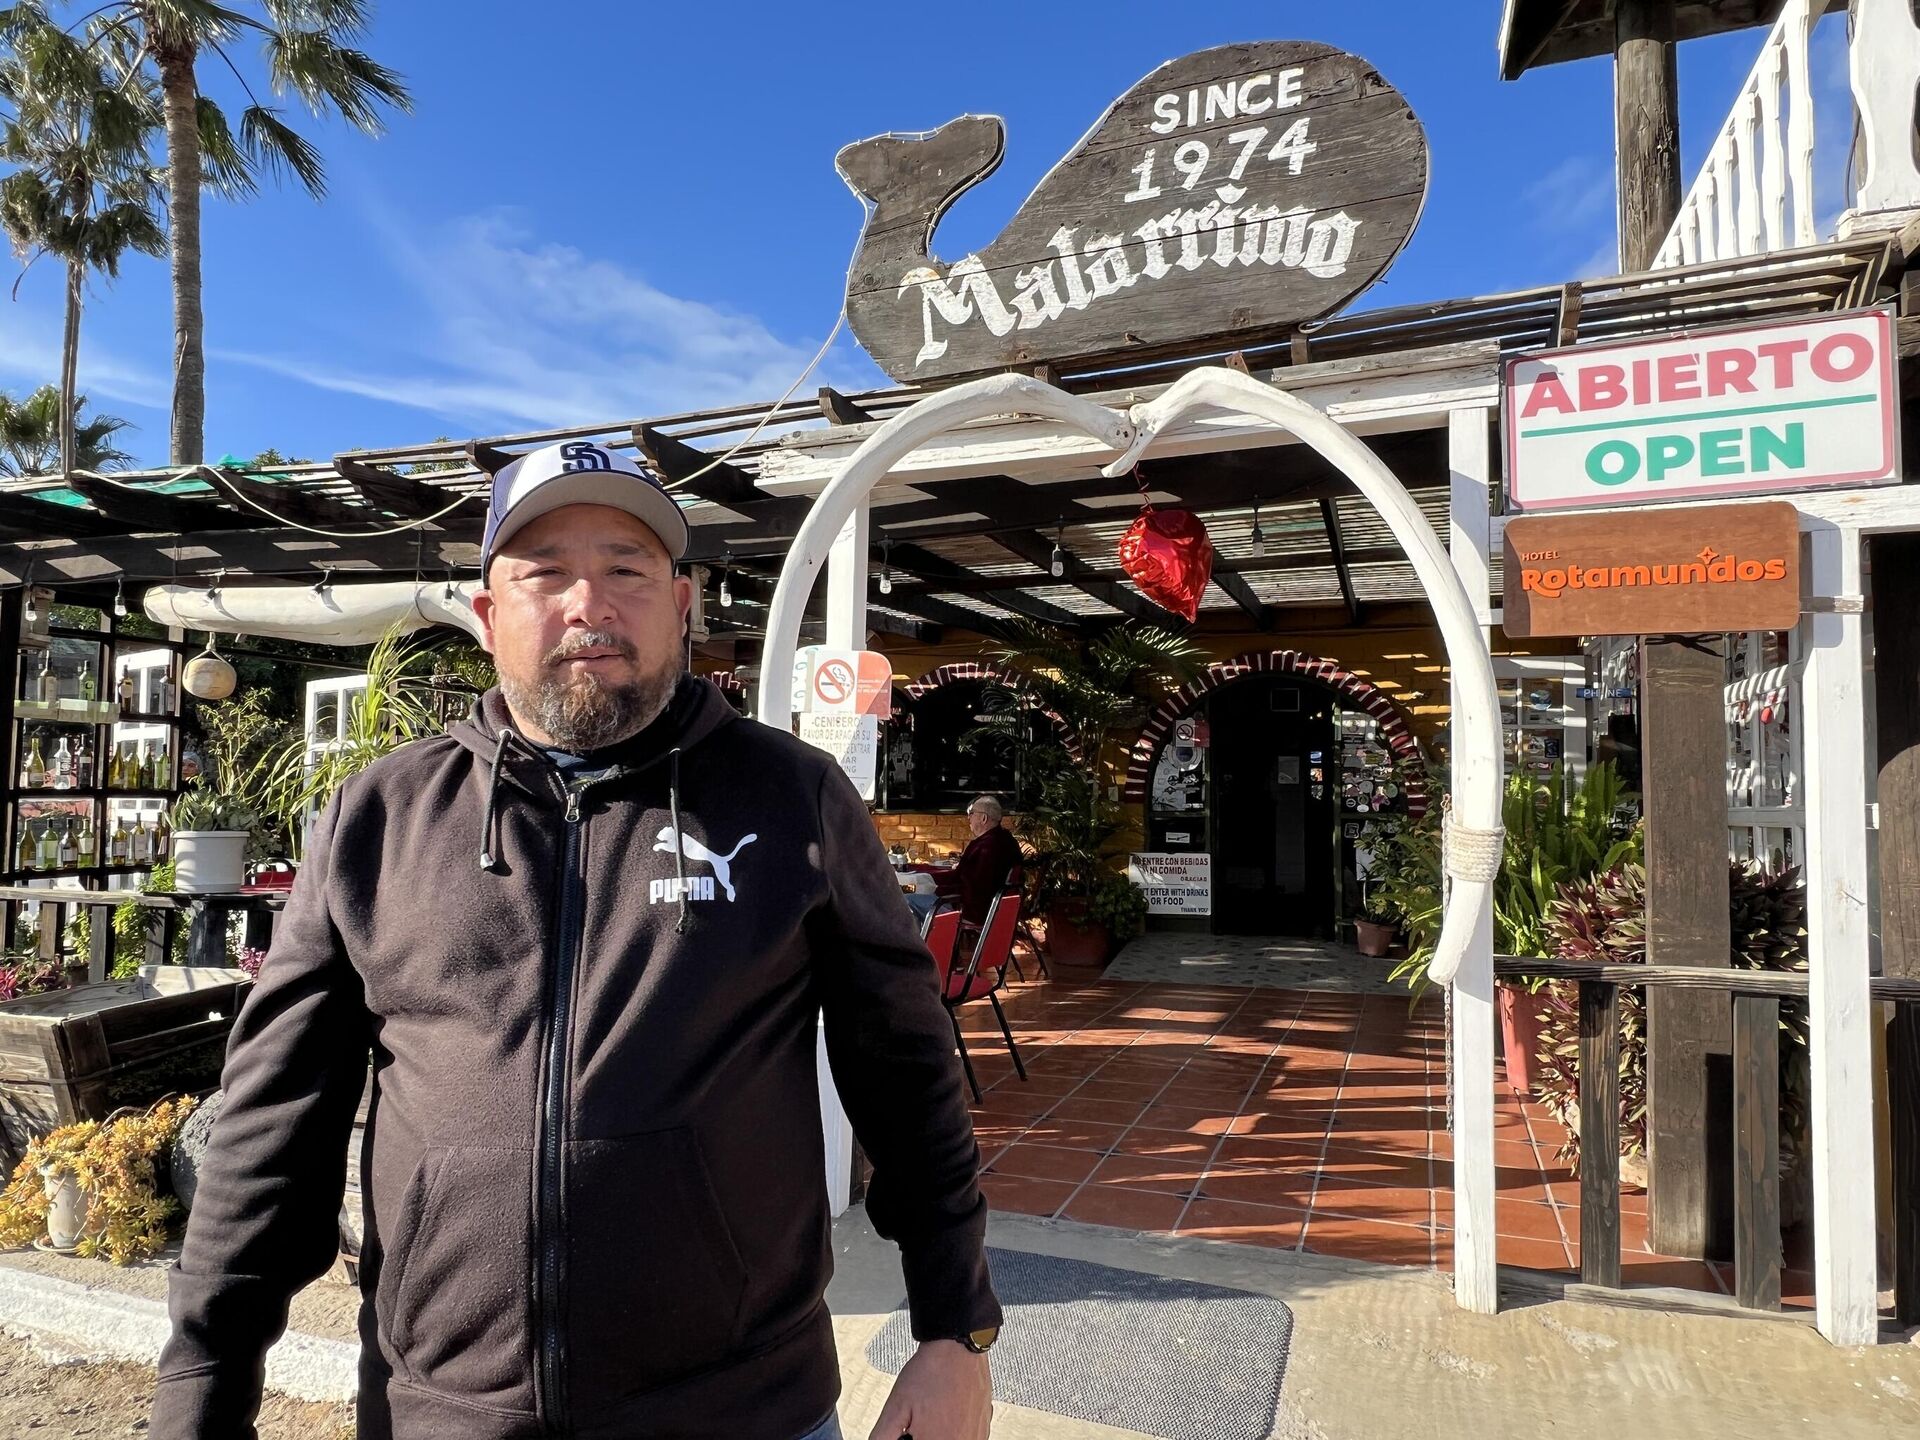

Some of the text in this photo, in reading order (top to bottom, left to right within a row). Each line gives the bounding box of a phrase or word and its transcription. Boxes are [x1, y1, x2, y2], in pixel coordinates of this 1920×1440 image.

[1150, 67, 1306, 135] SINCE
[1124, 117, 1318, 203] 1974
[897, 185, 1363, 368] Malarrimo
[1520, 332, 1874, 418] ABIERTO
[1584, 422, 1806, 486] OPEN
[1522, 551, 1560, 562] HOTEL
[1521, 555, 1787, 598] Rotamundos
[1583, 688, 1622, 698] PHNE
[803, 729, 824, 740] FAVOR
[862, 729, 871, 741] SU
[1141, 857, 1164, 866] ENTRE
[1165, 857, 1179, 866] CON
[1180, 857, 1209, 866] BEBIDAS
[1149, 866, 1188, 875] NI COMIDA
[1150, 887, 1170, 897] ENTER
[1170, 888, 1186, 897] WITH
[1186, 888, 1209, 897] DRINKS
[1150, 897, 1184, 906] OR FOOD
